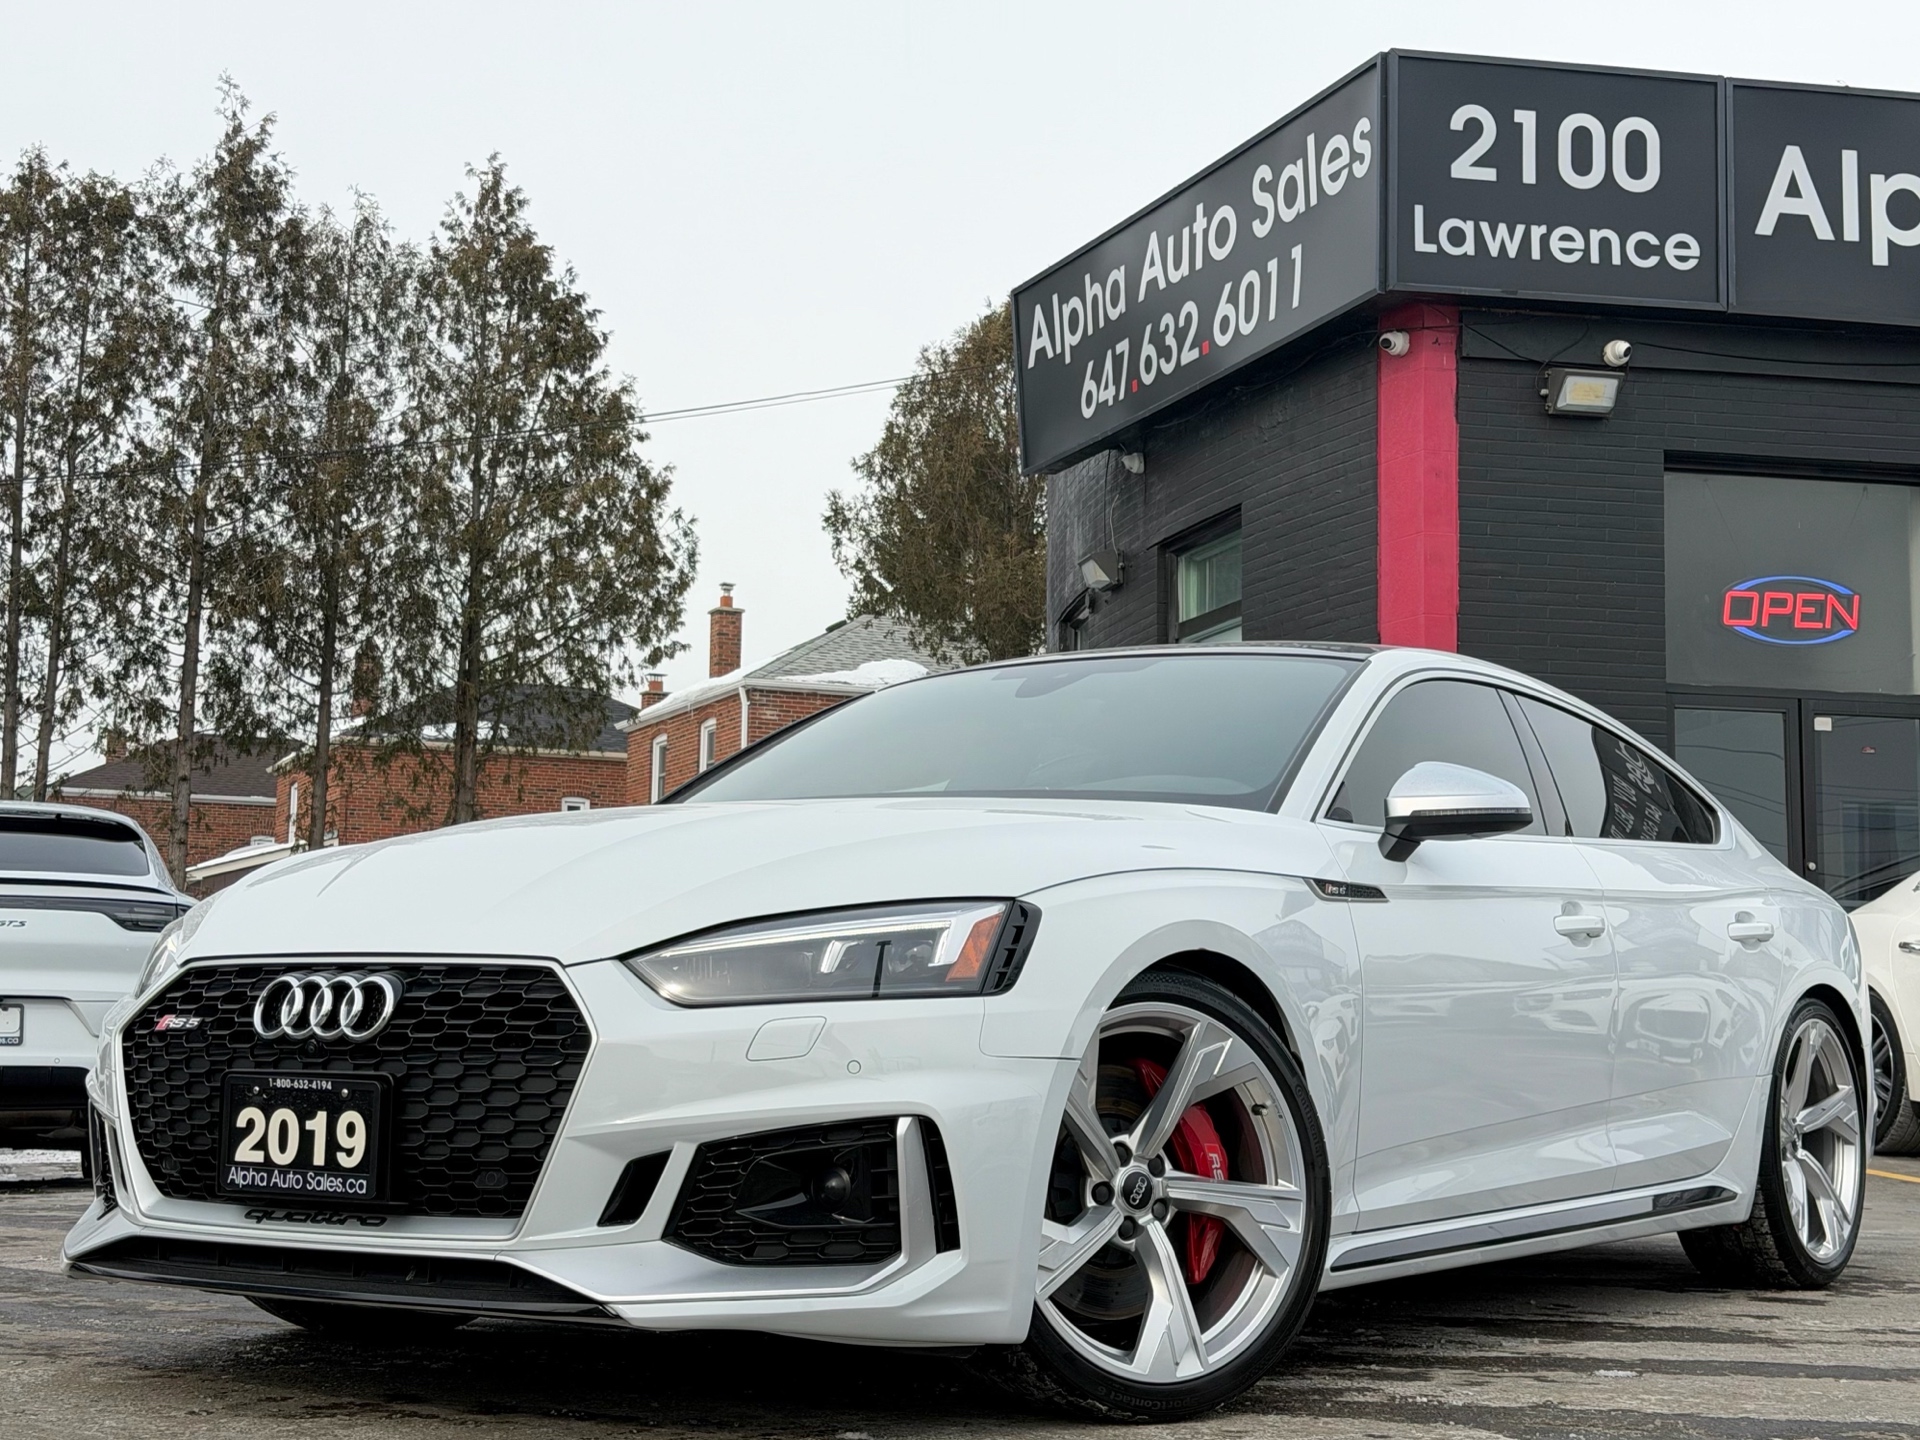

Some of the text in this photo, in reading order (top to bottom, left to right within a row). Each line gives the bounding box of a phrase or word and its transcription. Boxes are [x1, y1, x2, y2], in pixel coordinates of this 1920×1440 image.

[1449, 104, 1661, 193] 2100
[1027, 116, 1372, 369] Alpha Auto Sales
[1413, 204, 1701, 271] Lawrence
[1080, 243, 1303, 420] 647.632.6011
[1722, 590, 1860, 631] OPEN
[269, 1078, 333, 1091] 1-800-632-4194
[234, 1106, 367, 1169] 2019
[227, 1166, 367, 1195] Alpha Auto Sales.ca
[244, 1209, 388, 1228] quattro
